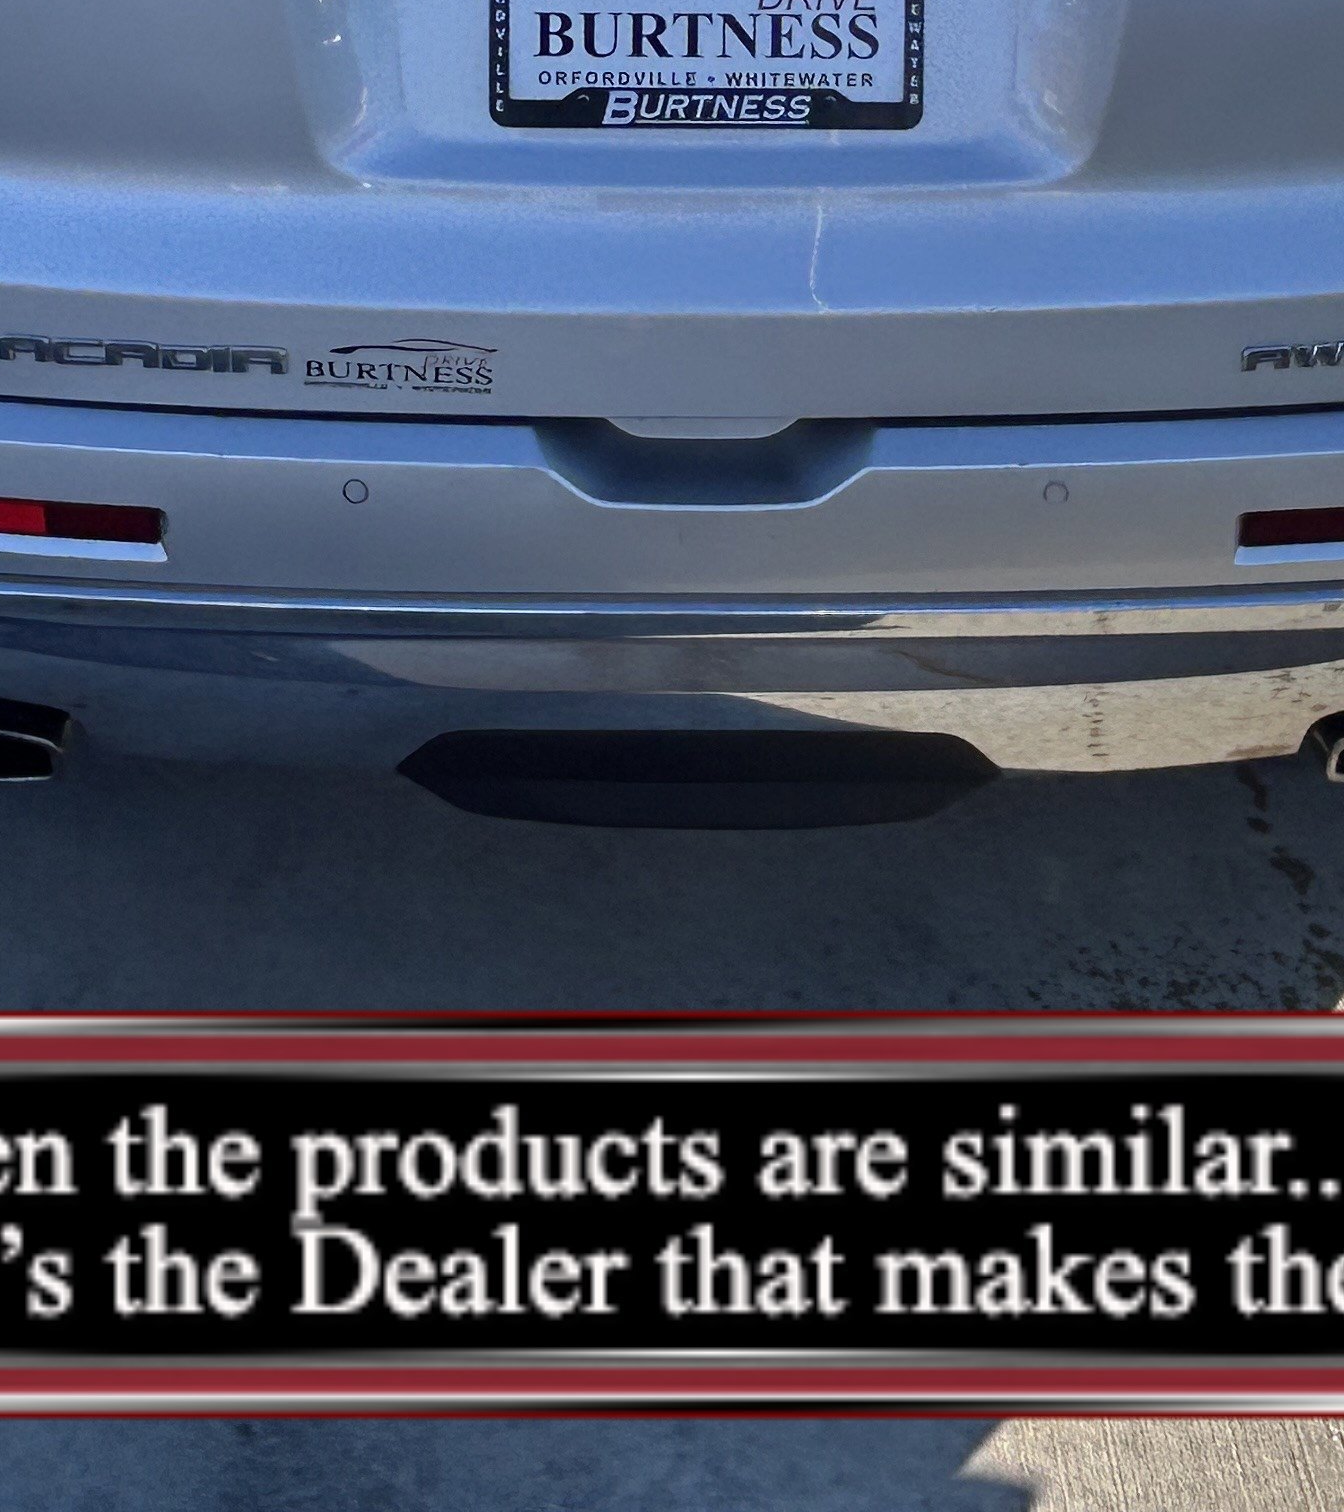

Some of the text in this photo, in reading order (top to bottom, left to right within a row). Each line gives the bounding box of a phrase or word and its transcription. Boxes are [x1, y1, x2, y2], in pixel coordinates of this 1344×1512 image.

[533, 10, 880, 60] BURTNESS
[538, 70, 875, 88] ORFORDVILLE WHITEWATER
[306, 360, 494, 386] BURTNESS
